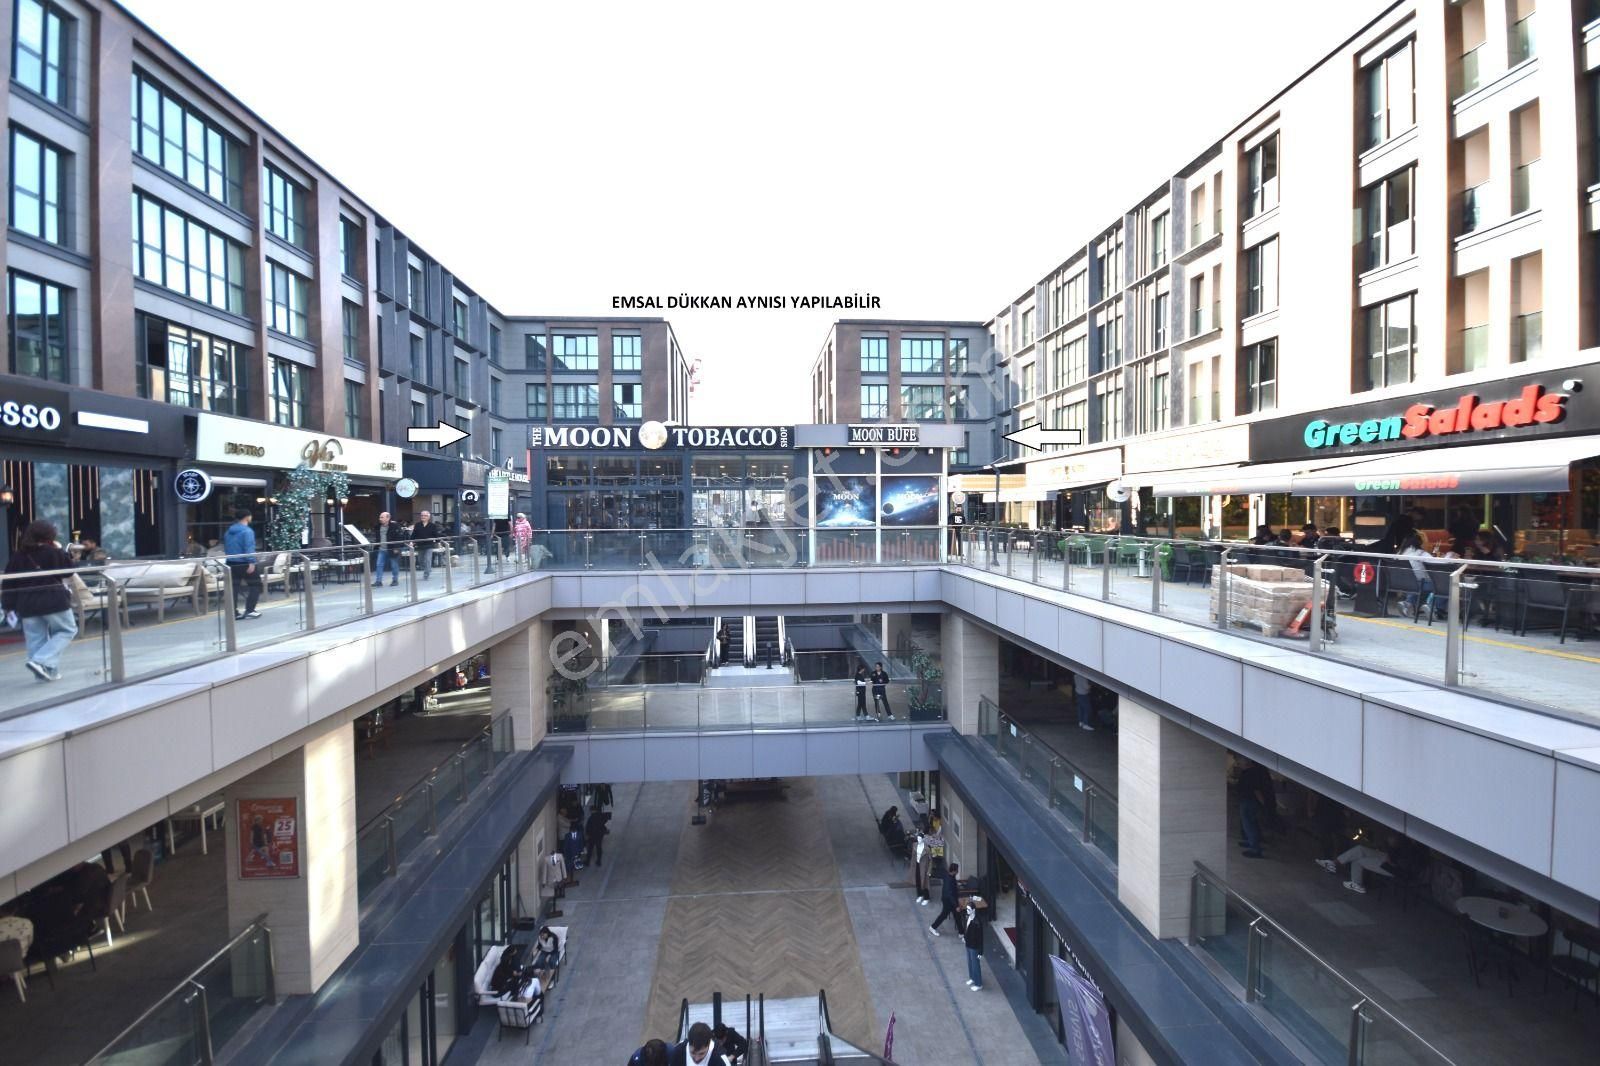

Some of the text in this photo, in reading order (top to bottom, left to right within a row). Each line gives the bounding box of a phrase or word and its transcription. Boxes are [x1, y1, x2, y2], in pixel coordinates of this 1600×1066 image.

[0, 401, 61, 430] sso
[532, 427, 788, 448] THE MOON TOBACCO SHOP
[852, 428, 884, 442] MOON
[833, 493, 860, 501] MOON
[277, 821, 292, 832] 25
